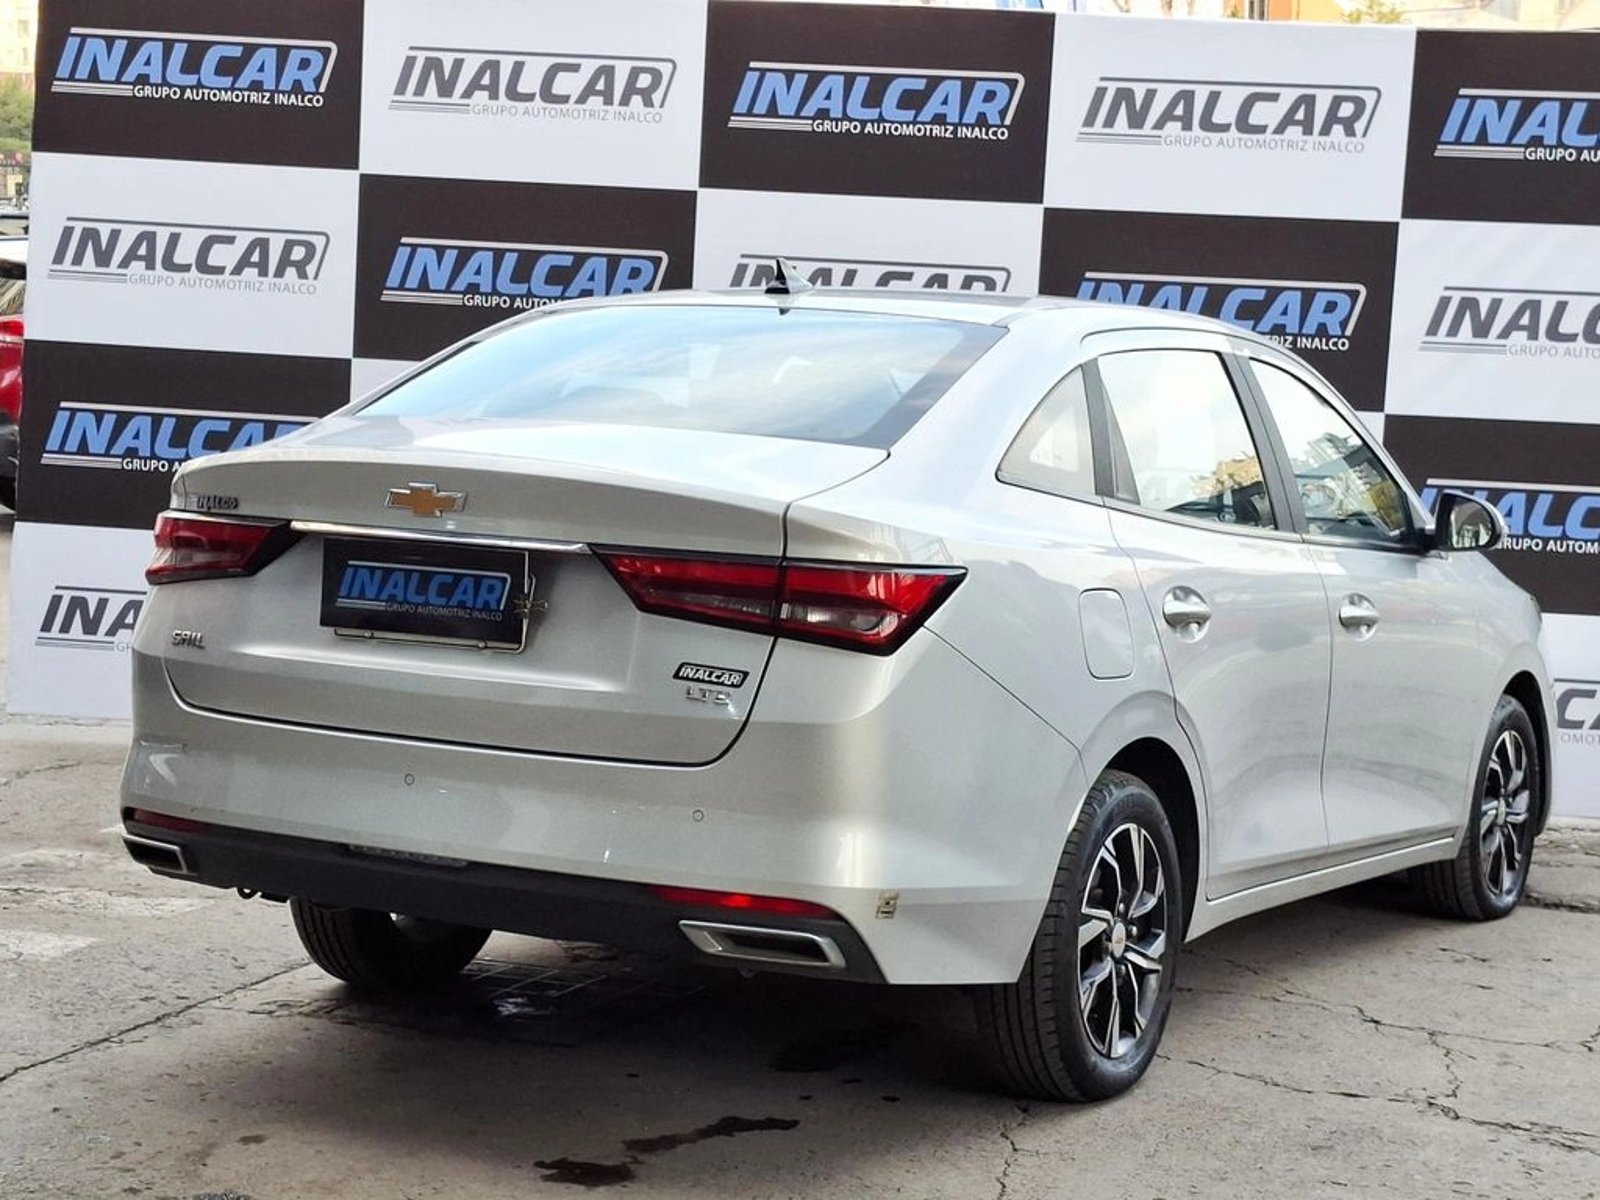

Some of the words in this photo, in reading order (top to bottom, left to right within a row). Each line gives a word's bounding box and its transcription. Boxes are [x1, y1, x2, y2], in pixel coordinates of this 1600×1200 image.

[55, 36, 324, 92] INALCAR
[393, 55, 663, 109] INALCAR
[133, 85, 181, 100] GRUPO
[183, 88, 271, 105] AUTOMOTRIZ
[274, 93, 324, 107] INALCO
[732, 71, 1011, 126] INALCAR
[471, 103, 519, 118] GRUPO
[522, 105, 610, 122] AUTOMOTRIZ
[613, 110, 663, 124] INALCO
[1081, 86, 1368, 138] INALCAR
[812, 119, 861, 134] GRUPO
[864, 121, 954, 139] AUTOMOTRIZ
[957, 125, 1009, 140] INALCO
[1163, 135, 1213, 148] GRUPO
[1216, 137, 1308, 152] AUTOMOTRIZ
[1312, 140, 1365, 154] INALCO
[1525, 146, 1576, 161] GRUPO
[51, 225, 318, 281] INALCAR
[385, 245, 655, 298] INALCAR
[128, 273, 175, 288] GRUPO
[178, 276, 265, 293] AUTOMOTRIZ
[268, 281, 318, 296] INALCO
[463, 294, 510, 309] GRUPO
[1296, 336, 1350, 351] INALCO
[1508, 344, 1559, 358] GRUPO
[45, 409, 303, 460] INALCA
[122, 457, 169, 473] GRUPO
[339, 566, 506, 610] INALCAR
[39, 594, 144, 637] INA
[386, 602, 416, 614] GRUPO
[416, 605, 471, 618] AUTOMOTRIZ
[171, 630, 206, 650] SAIL
[679, 664, 741, 686] INALCAR
